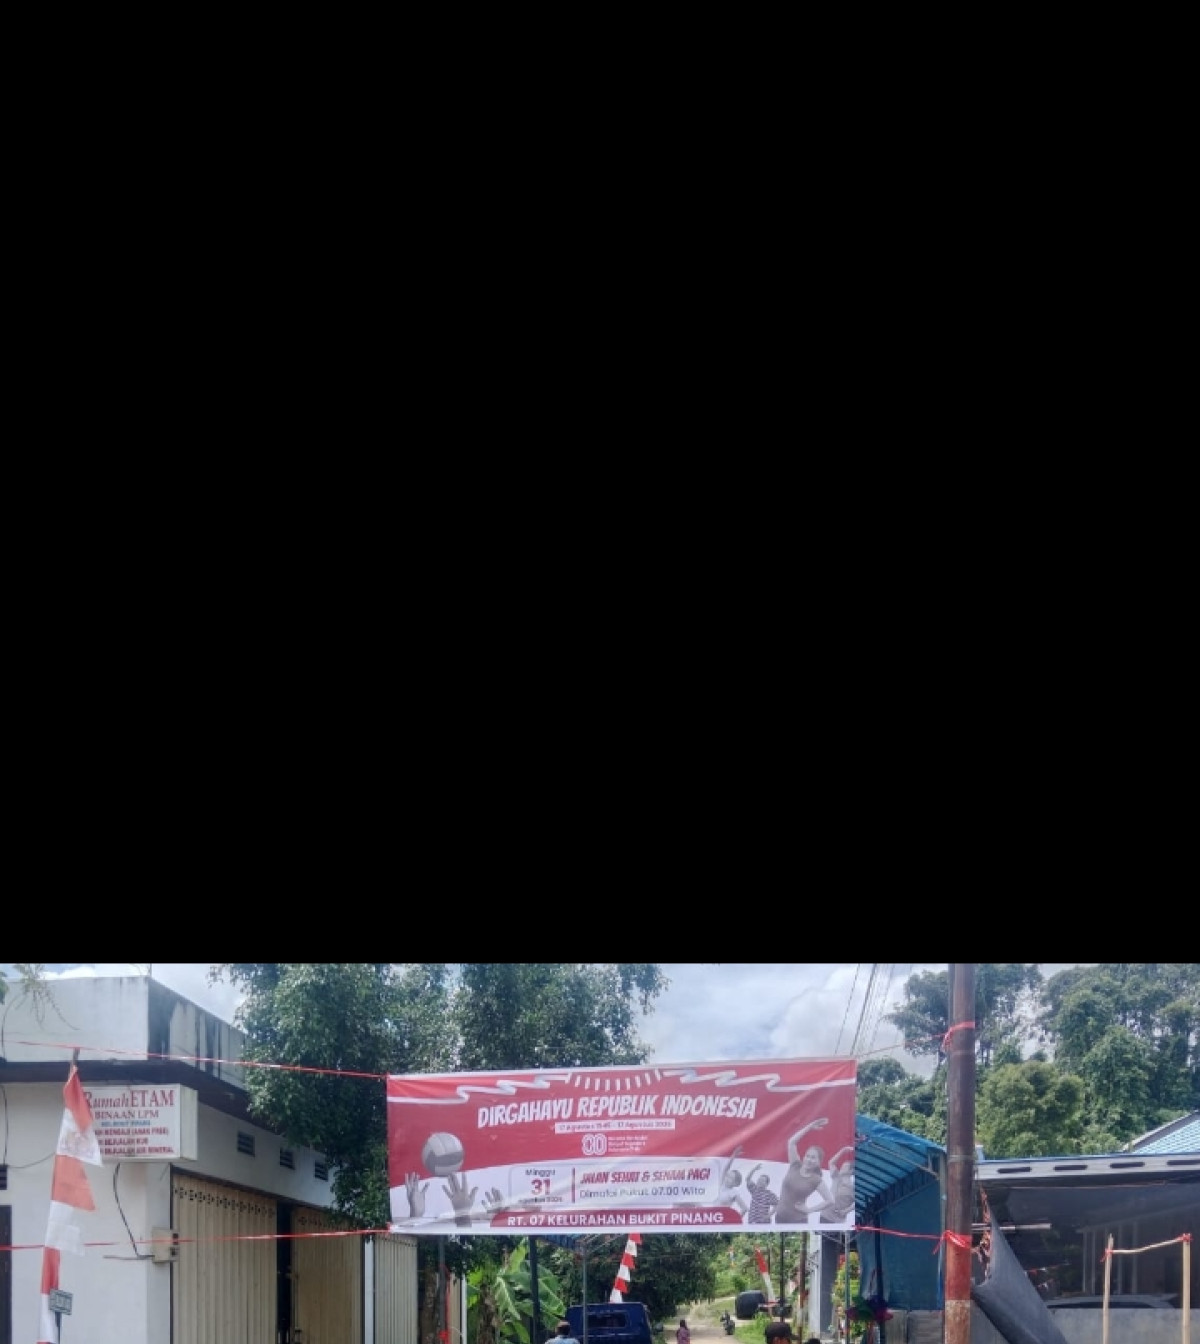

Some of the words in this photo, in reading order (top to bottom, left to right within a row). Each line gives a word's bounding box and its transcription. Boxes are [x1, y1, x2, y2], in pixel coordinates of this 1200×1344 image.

[94, 1110, 136, 1120] BINAAN
[477, 1098, 574, 1129] DIRGAHAYU
[576, 1095, 660, 1118] REPUBLIK
[660, 1094, 758, 1119] INDONESIA
[525, 1168, 556, 1178] Minggu
[580, 1171, 609, 1184] JALAN
[610, 1171, 641, 1184] SEHAT
[641, 1169, 651, 1182] &
[687, 1167, 711, 1181] PAGI
[531, 1178, 551, 1195] 31
[651, 1186, 679, 1196] 07.00
[507, 1216, 528, 1227] RT.
[529, 1214, 546, 1227] 07
[547, 1213, 627, 1227] KELURAHAN
[629, 1212, 669, 1225] BUKIT
[671, 1211, 724, 1224] PINANG
